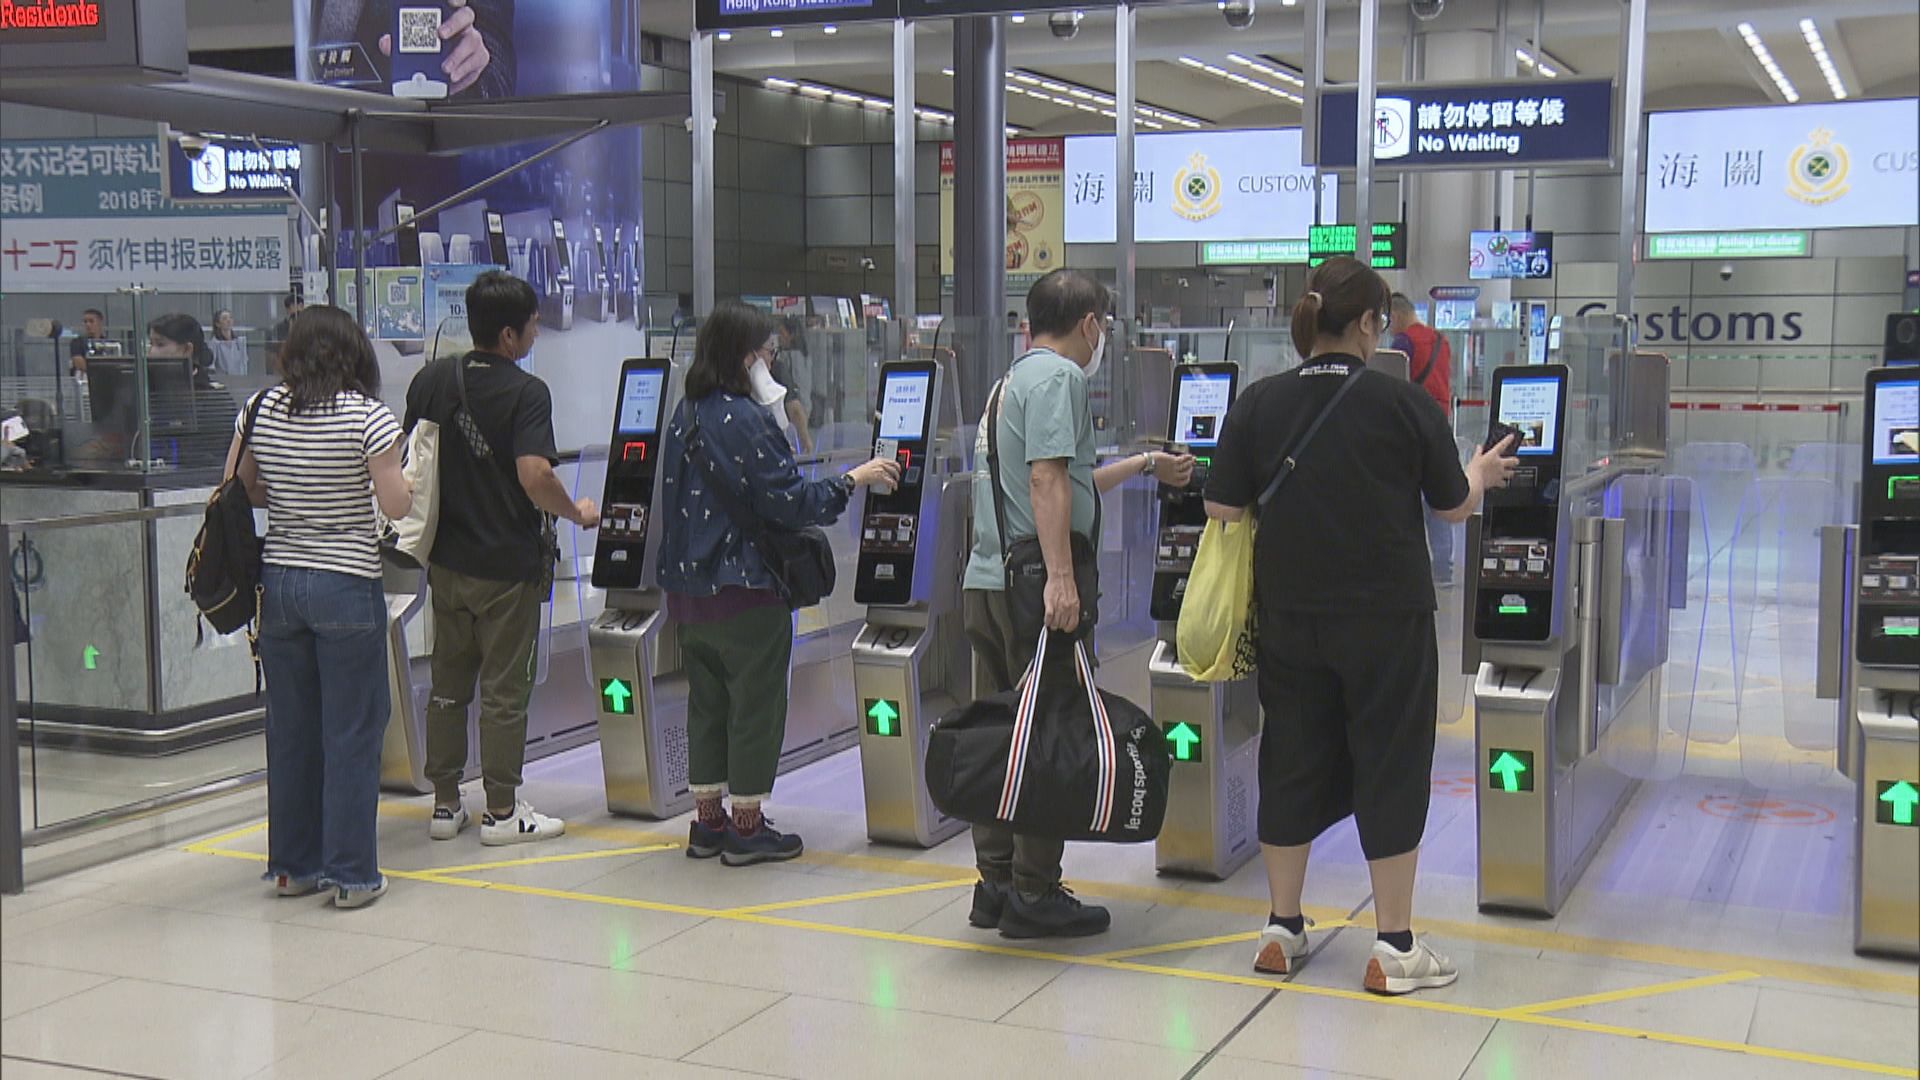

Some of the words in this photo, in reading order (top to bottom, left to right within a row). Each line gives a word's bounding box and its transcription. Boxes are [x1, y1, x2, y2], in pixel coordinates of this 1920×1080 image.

[0, 0, 99, 29] Residents
[1418, 98, 1565, 130] 請勿停留等候
[1418, 134, 1444, 152] No
[1449, 132, 1520, 153] Waiting
[229, 173, 247, 190] No
[1659, 153, 1698, 189] 海
[1724, 150, 1763, 188] 關
[1074, 171, 1105, 205] 海
[4, 239, 79, 271] 十二万
[88, 236, 282, 271] 须作申报或披露
[599, 609, 645, 631] 20
[870, 628, 909, 650] 19
[1494, 667, 1544, 693] 17
[1131, 788, 1147, 815] coq
